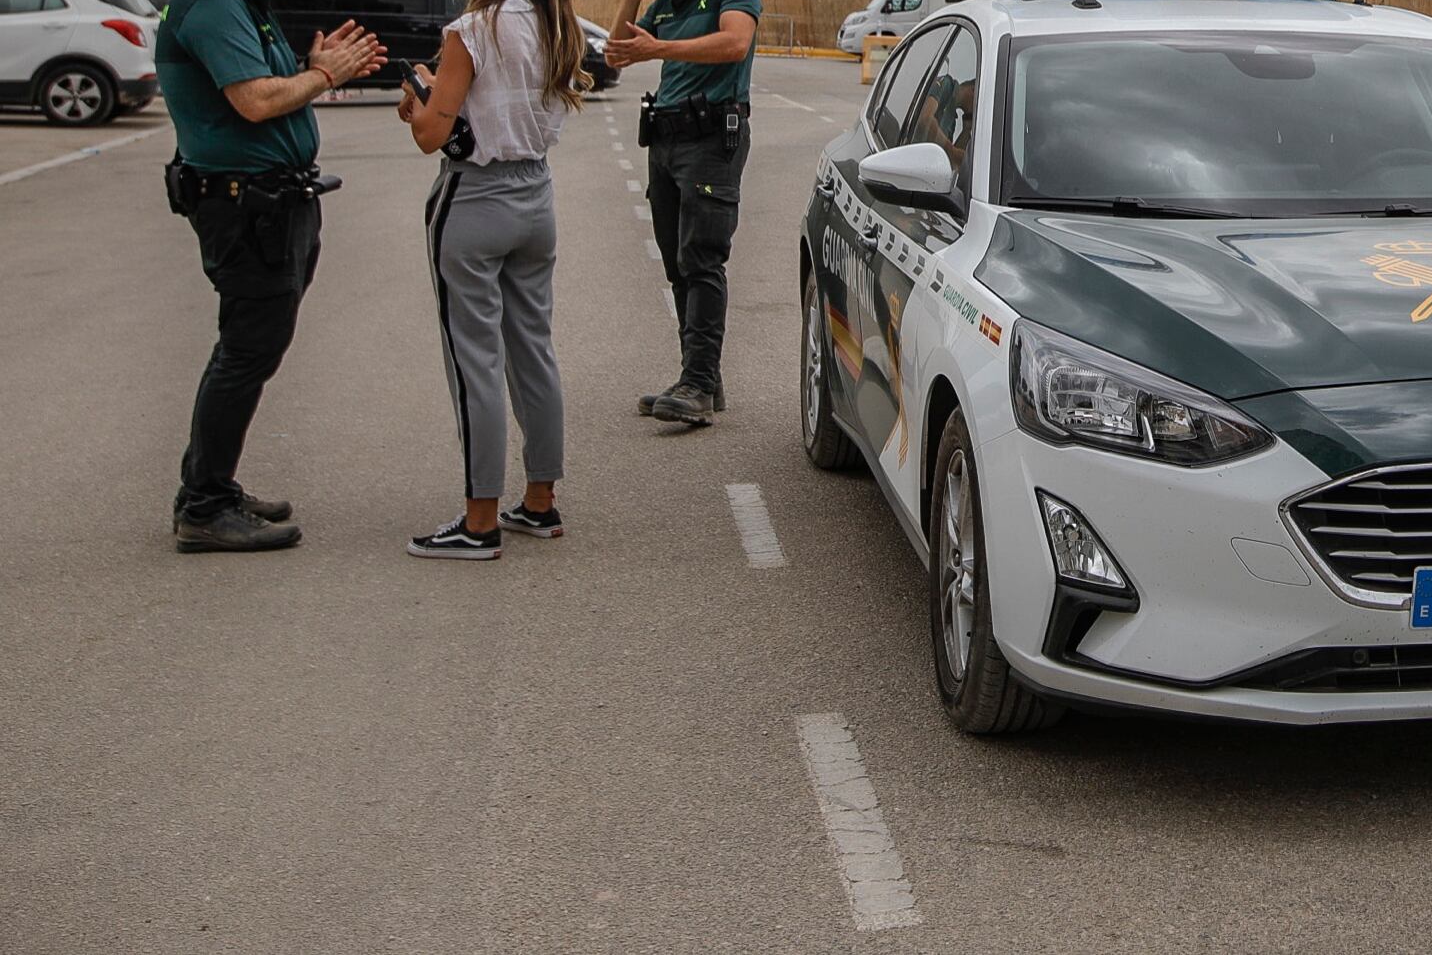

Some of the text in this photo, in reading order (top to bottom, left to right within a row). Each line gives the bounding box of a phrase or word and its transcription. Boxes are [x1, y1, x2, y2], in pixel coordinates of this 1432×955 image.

[822, 225, 877, 322] GUARDIA CIVIL
[943, 285, 979, 325] GUARDIA CIVIL
[1420, 605, 1430, 618] E
